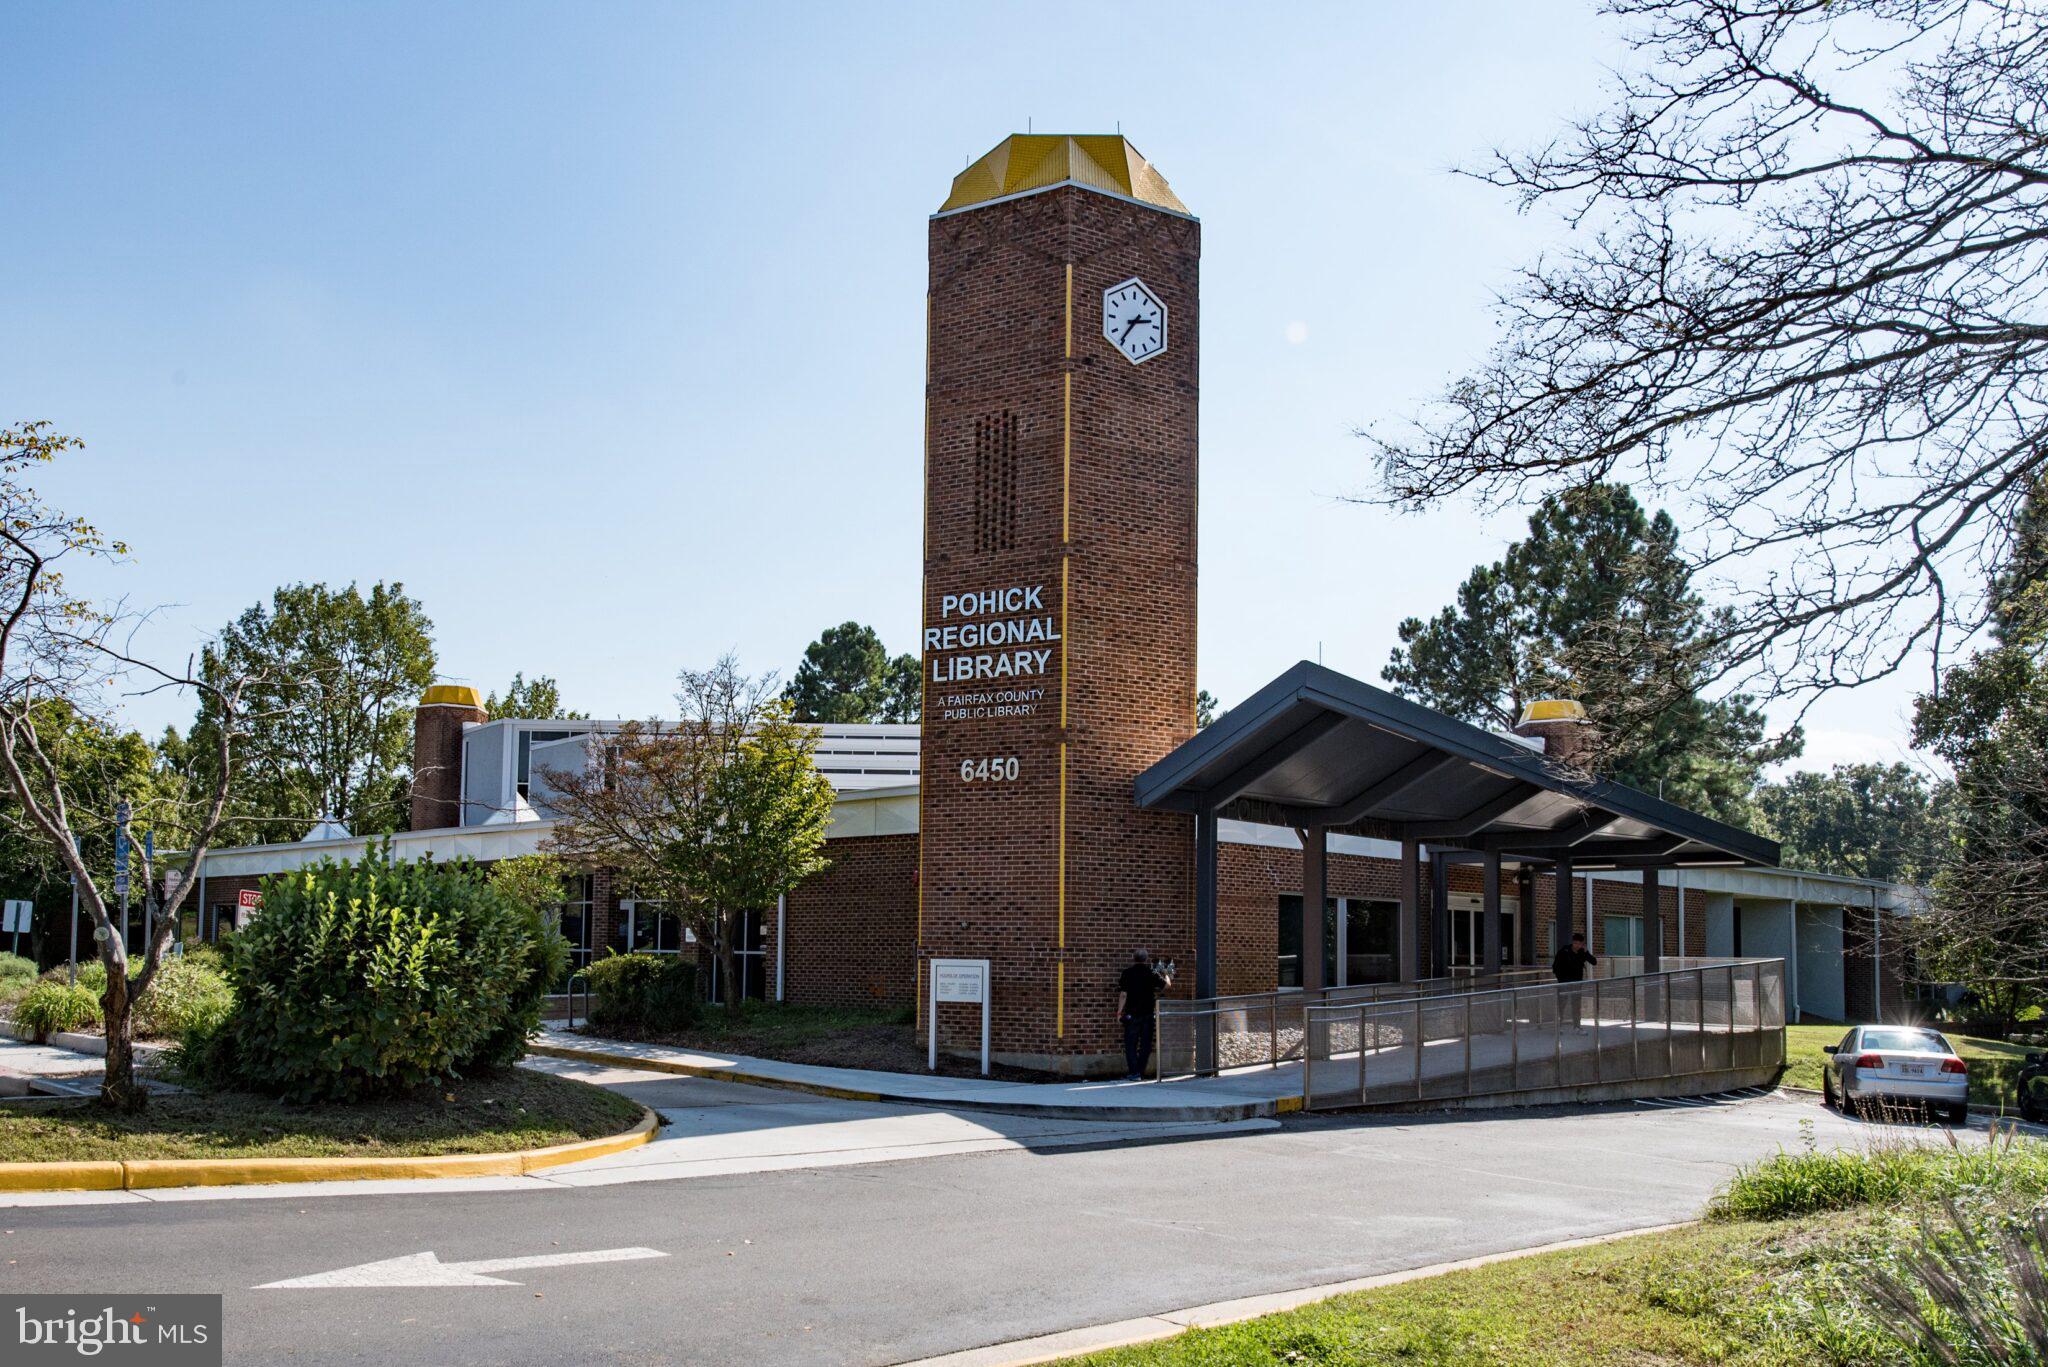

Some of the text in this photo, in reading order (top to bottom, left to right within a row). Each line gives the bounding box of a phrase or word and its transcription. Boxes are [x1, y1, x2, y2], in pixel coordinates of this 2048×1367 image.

[942, 585, 1044, 619] POHICK
[924, 617, 1062, 651] REGIONAL
[933, 649, 1052, 682] LIBRARY
[938, 689, 1045, 707] A FAIRFAX COUNTY
[944, 704, 1038, 720] PUBLIC LIBRARY
[960, 756, 1020, 783] 6450
